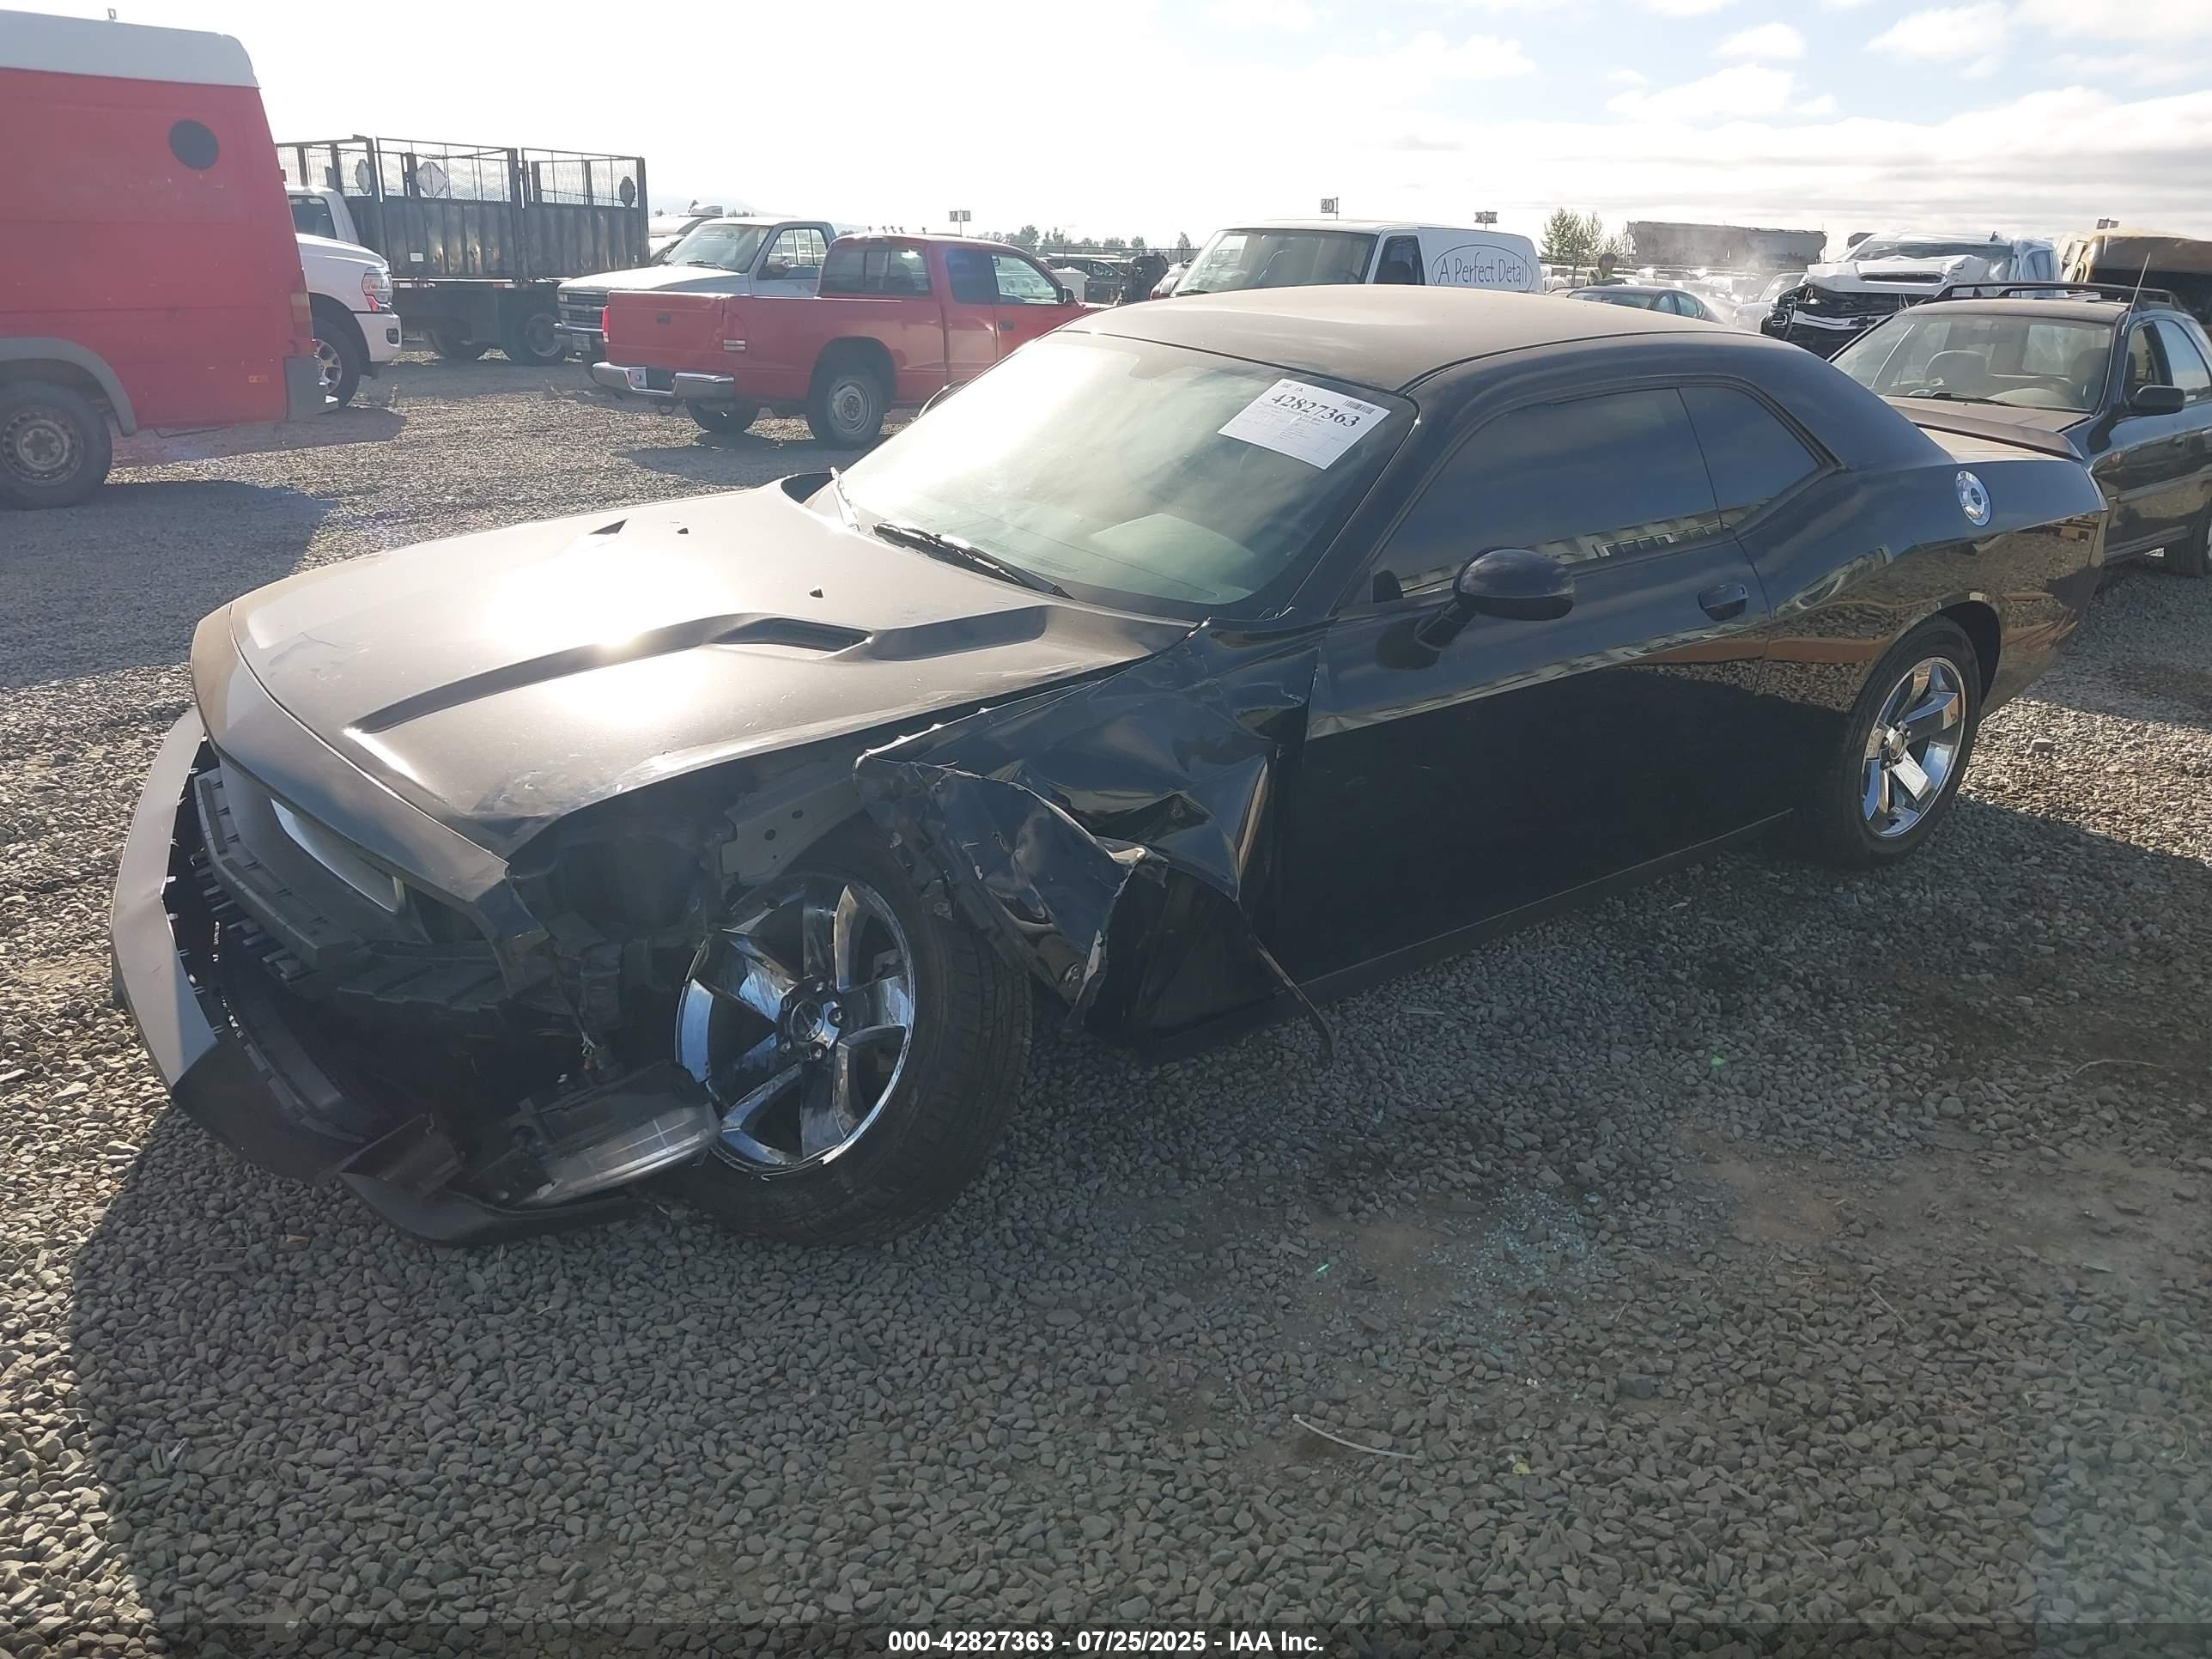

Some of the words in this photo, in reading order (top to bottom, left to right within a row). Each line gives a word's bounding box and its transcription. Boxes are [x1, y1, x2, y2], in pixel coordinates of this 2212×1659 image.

[1322, 198, 1334, 212] 40
[1437, 257, 1450, 284] A
[1455, 251, 1495, 283] Perfect
[1498, 254, 1528, 285] Detail
[1271, 393, 1361, 428] 42827363
